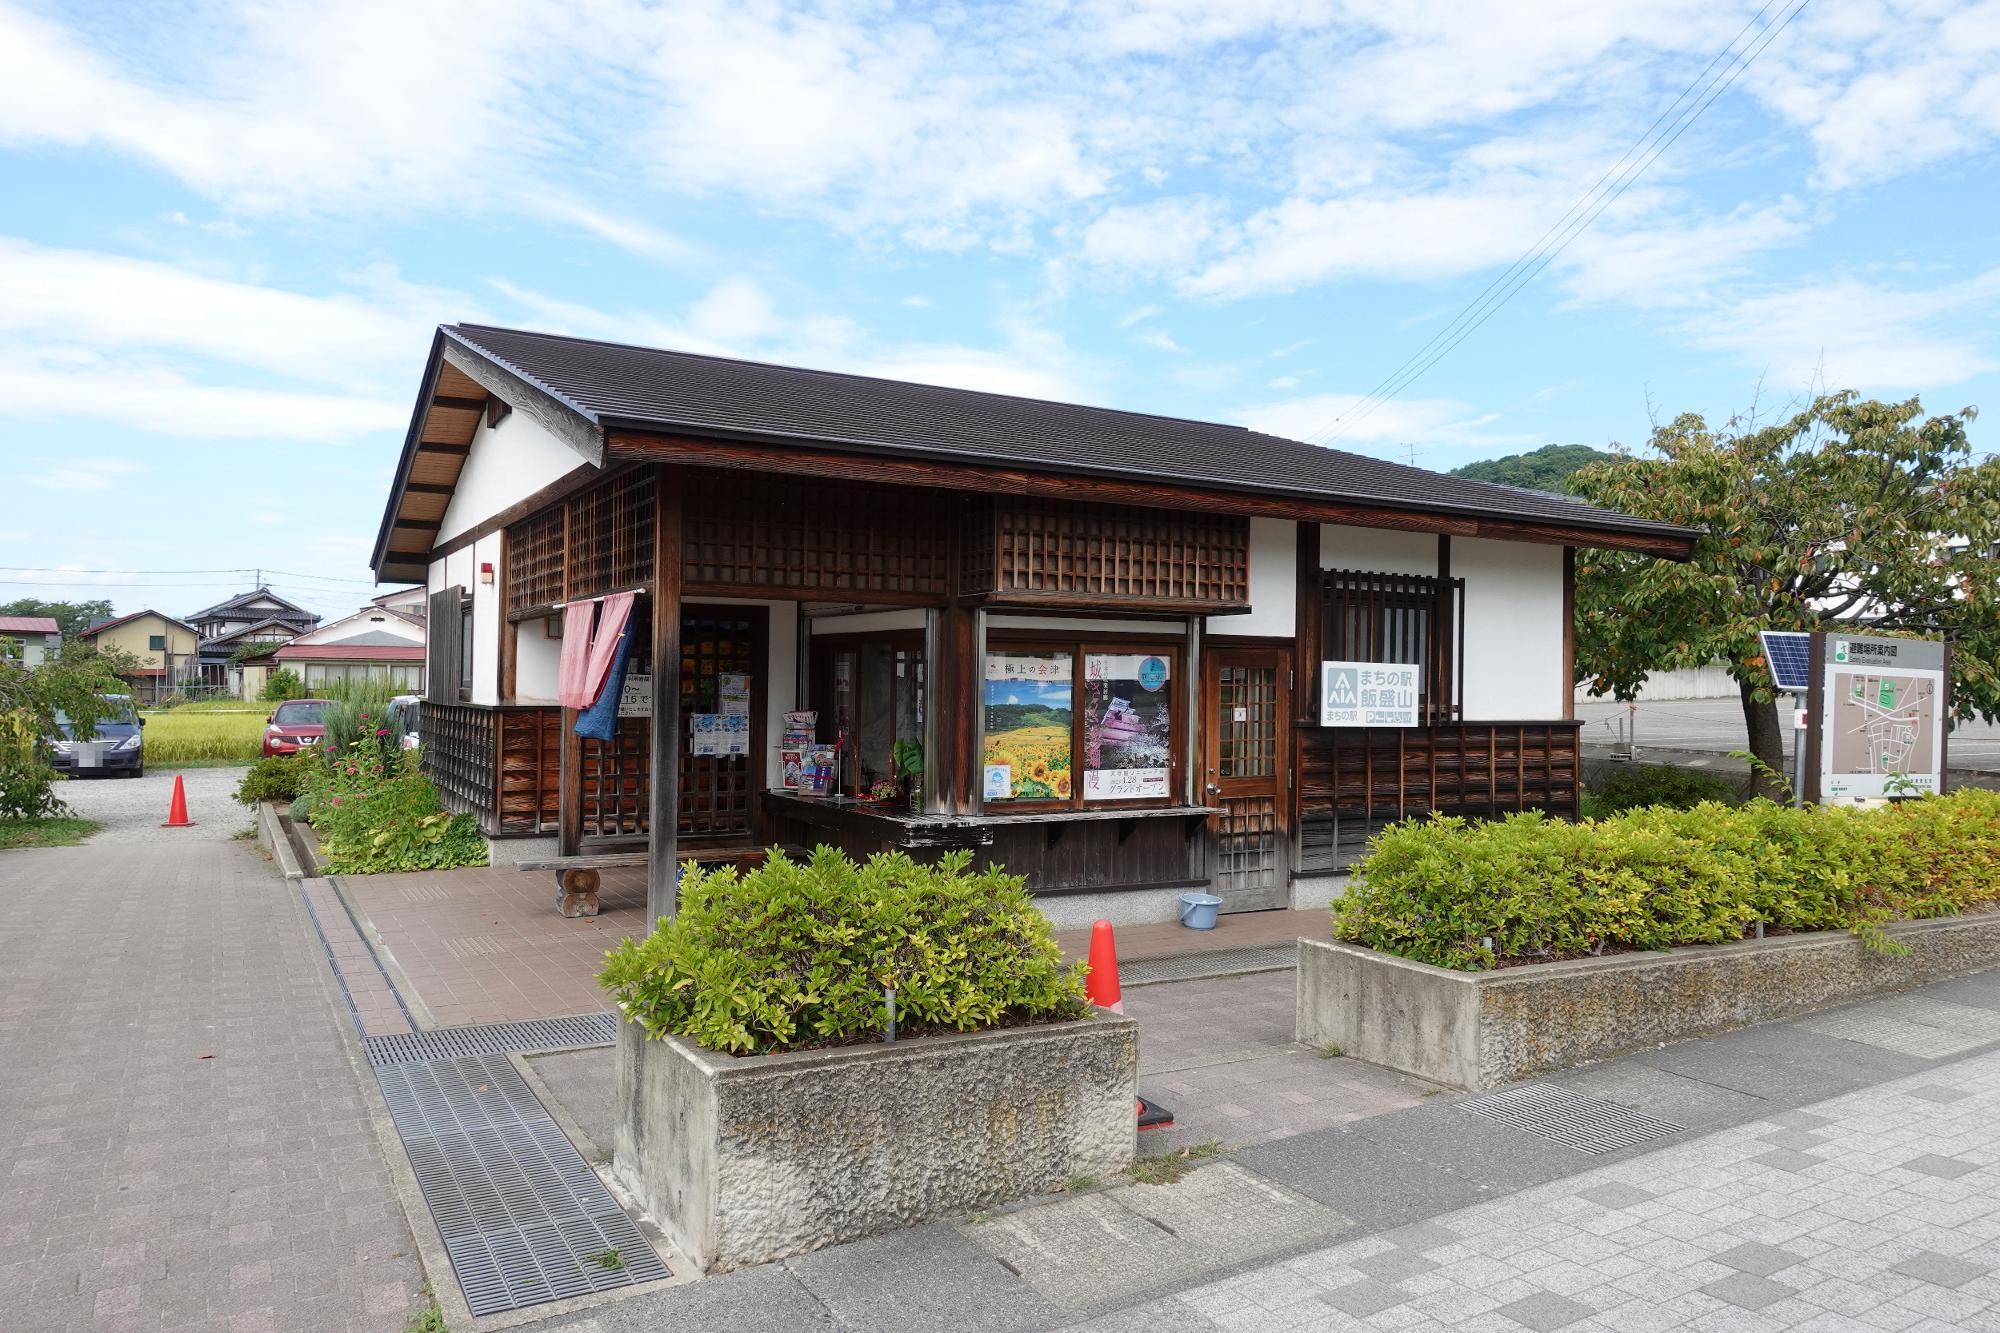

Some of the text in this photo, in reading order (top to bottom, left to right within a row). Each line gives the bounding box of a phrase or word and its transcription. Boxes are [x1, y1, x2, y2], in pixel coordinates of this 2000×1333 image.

[1849, 642, 1898, 657] 避難場所案内図
[1004, 663, 1060, 676] 極上の会津
[1361, 670, 1412, 687] まちの駅
[1361, 689, 1412, 709] 飯盛山
[1327, 711, 1358, 721] まちの駅
